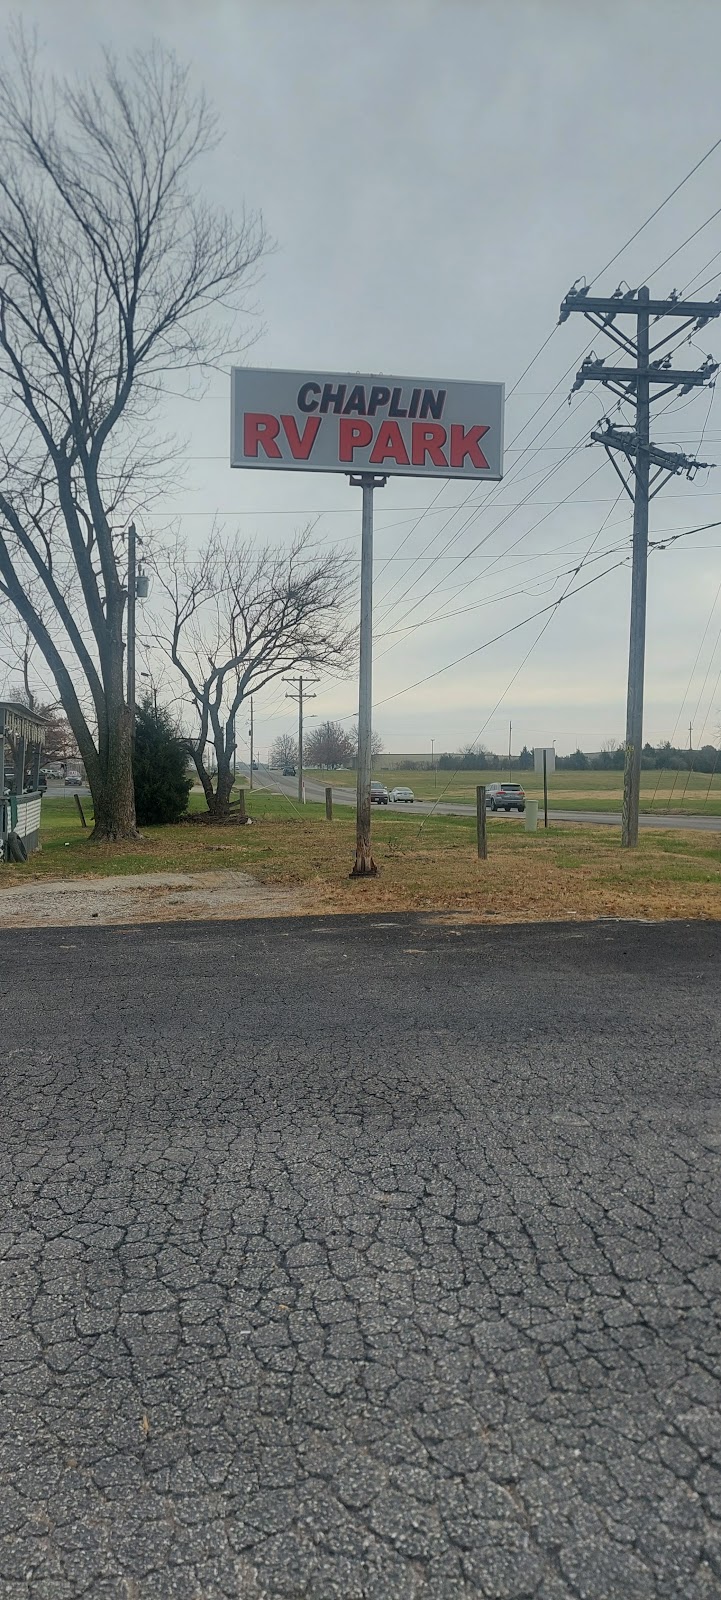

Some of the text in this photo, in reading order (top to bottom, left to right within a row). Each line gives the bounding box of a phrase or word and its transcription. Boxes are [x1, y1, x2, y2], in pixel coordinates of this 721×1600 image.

[297, 381, 446, 419] CHAPLIN
[243, 412, 491, 469] RV PARK
